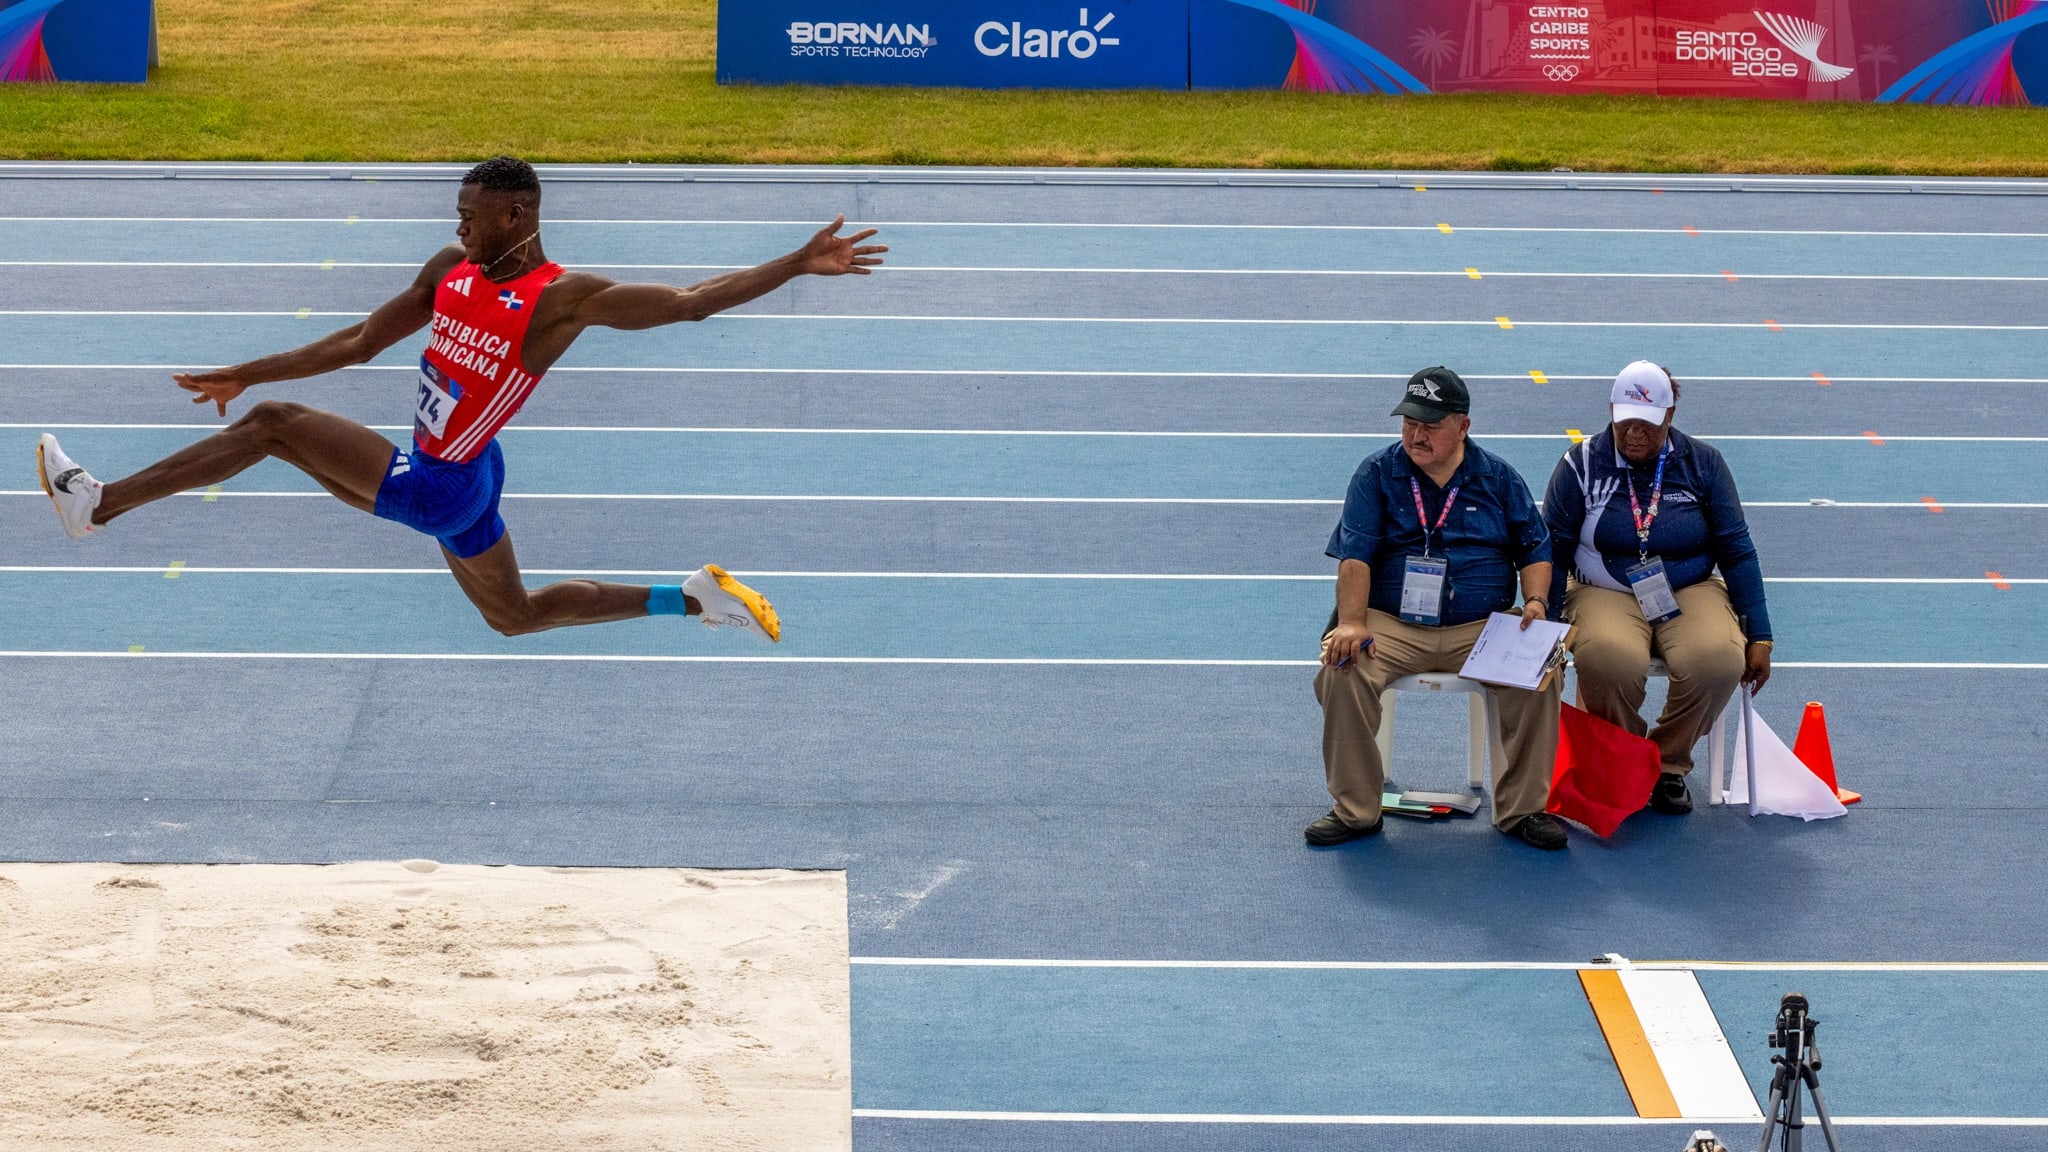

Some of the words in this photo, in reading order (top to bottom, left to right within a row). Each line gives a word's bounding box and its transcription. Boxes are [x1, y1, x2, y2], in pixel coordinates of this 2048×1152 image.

[1528, 6, 1589, 18] CENTRO
[789, 21, 930, 45] BORNAN
[1529, 21, 1589, 35] CARIBE
[974, 20, 1098, 59] Claro
[1530, 38, 1590, 50] SPORTS
[1675, 31, 1757, 46] SANTO
[790, 45, 840, 57] SPORTS
[843, 46, 929, 58] TECHNOLOGY
[1675, 46, 1782, 61] DOMINGO
[1732, 62, 1799, 77] 2026
[432, 310, 511, 360] EPUBLICA
[417, 376, 441, 424] 74
